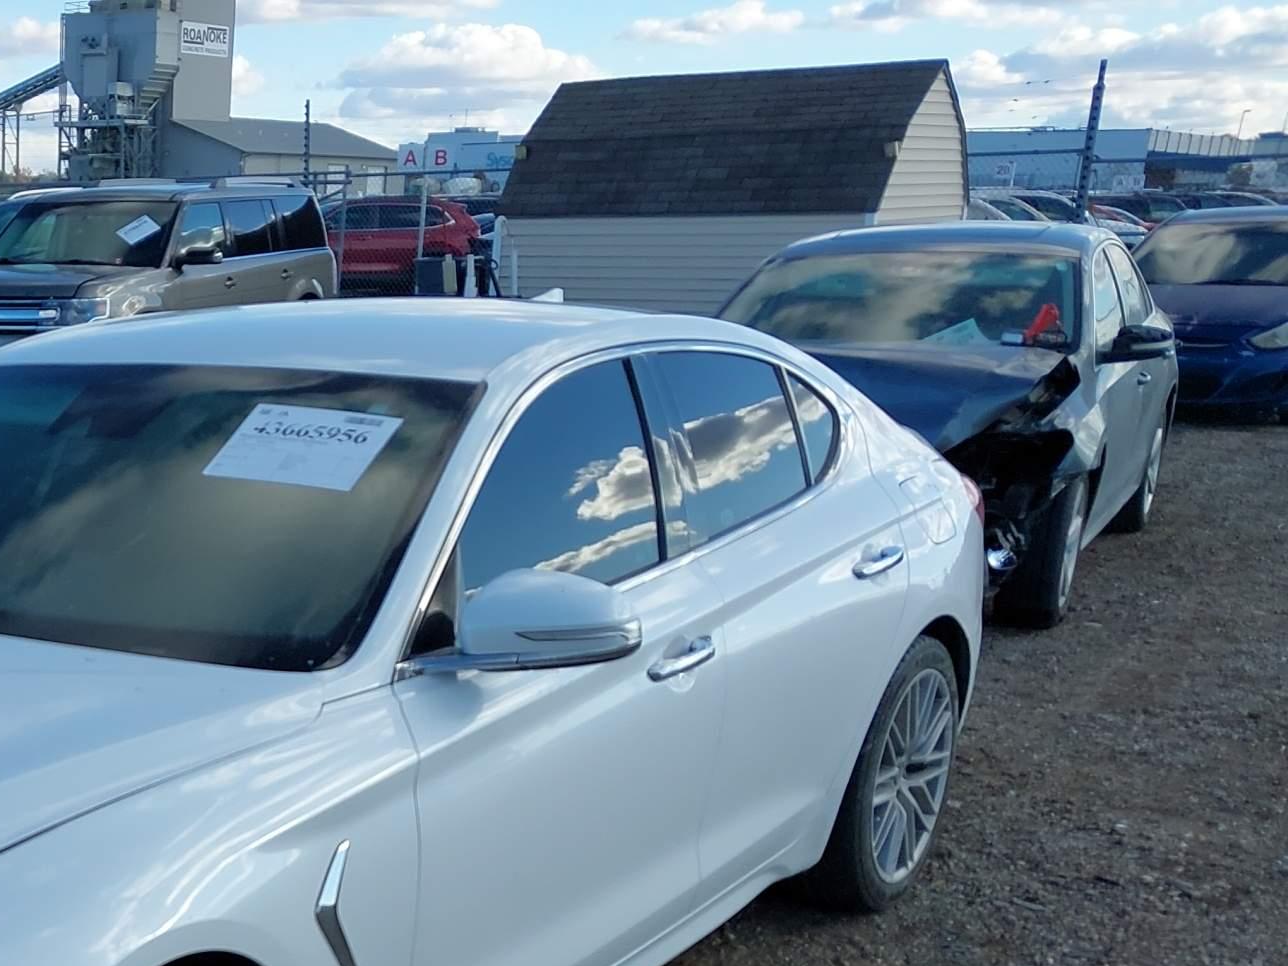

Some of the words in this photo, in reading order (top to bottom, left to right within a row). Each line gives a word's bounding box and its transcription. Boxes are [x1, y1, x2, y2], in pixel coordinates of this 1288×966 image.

[183, 27, 227, 44] ROANOKE
[403, 150, 417, 166] A
[435, 150, 447, 166] B
[253, 421, 371, 445] 43665956
